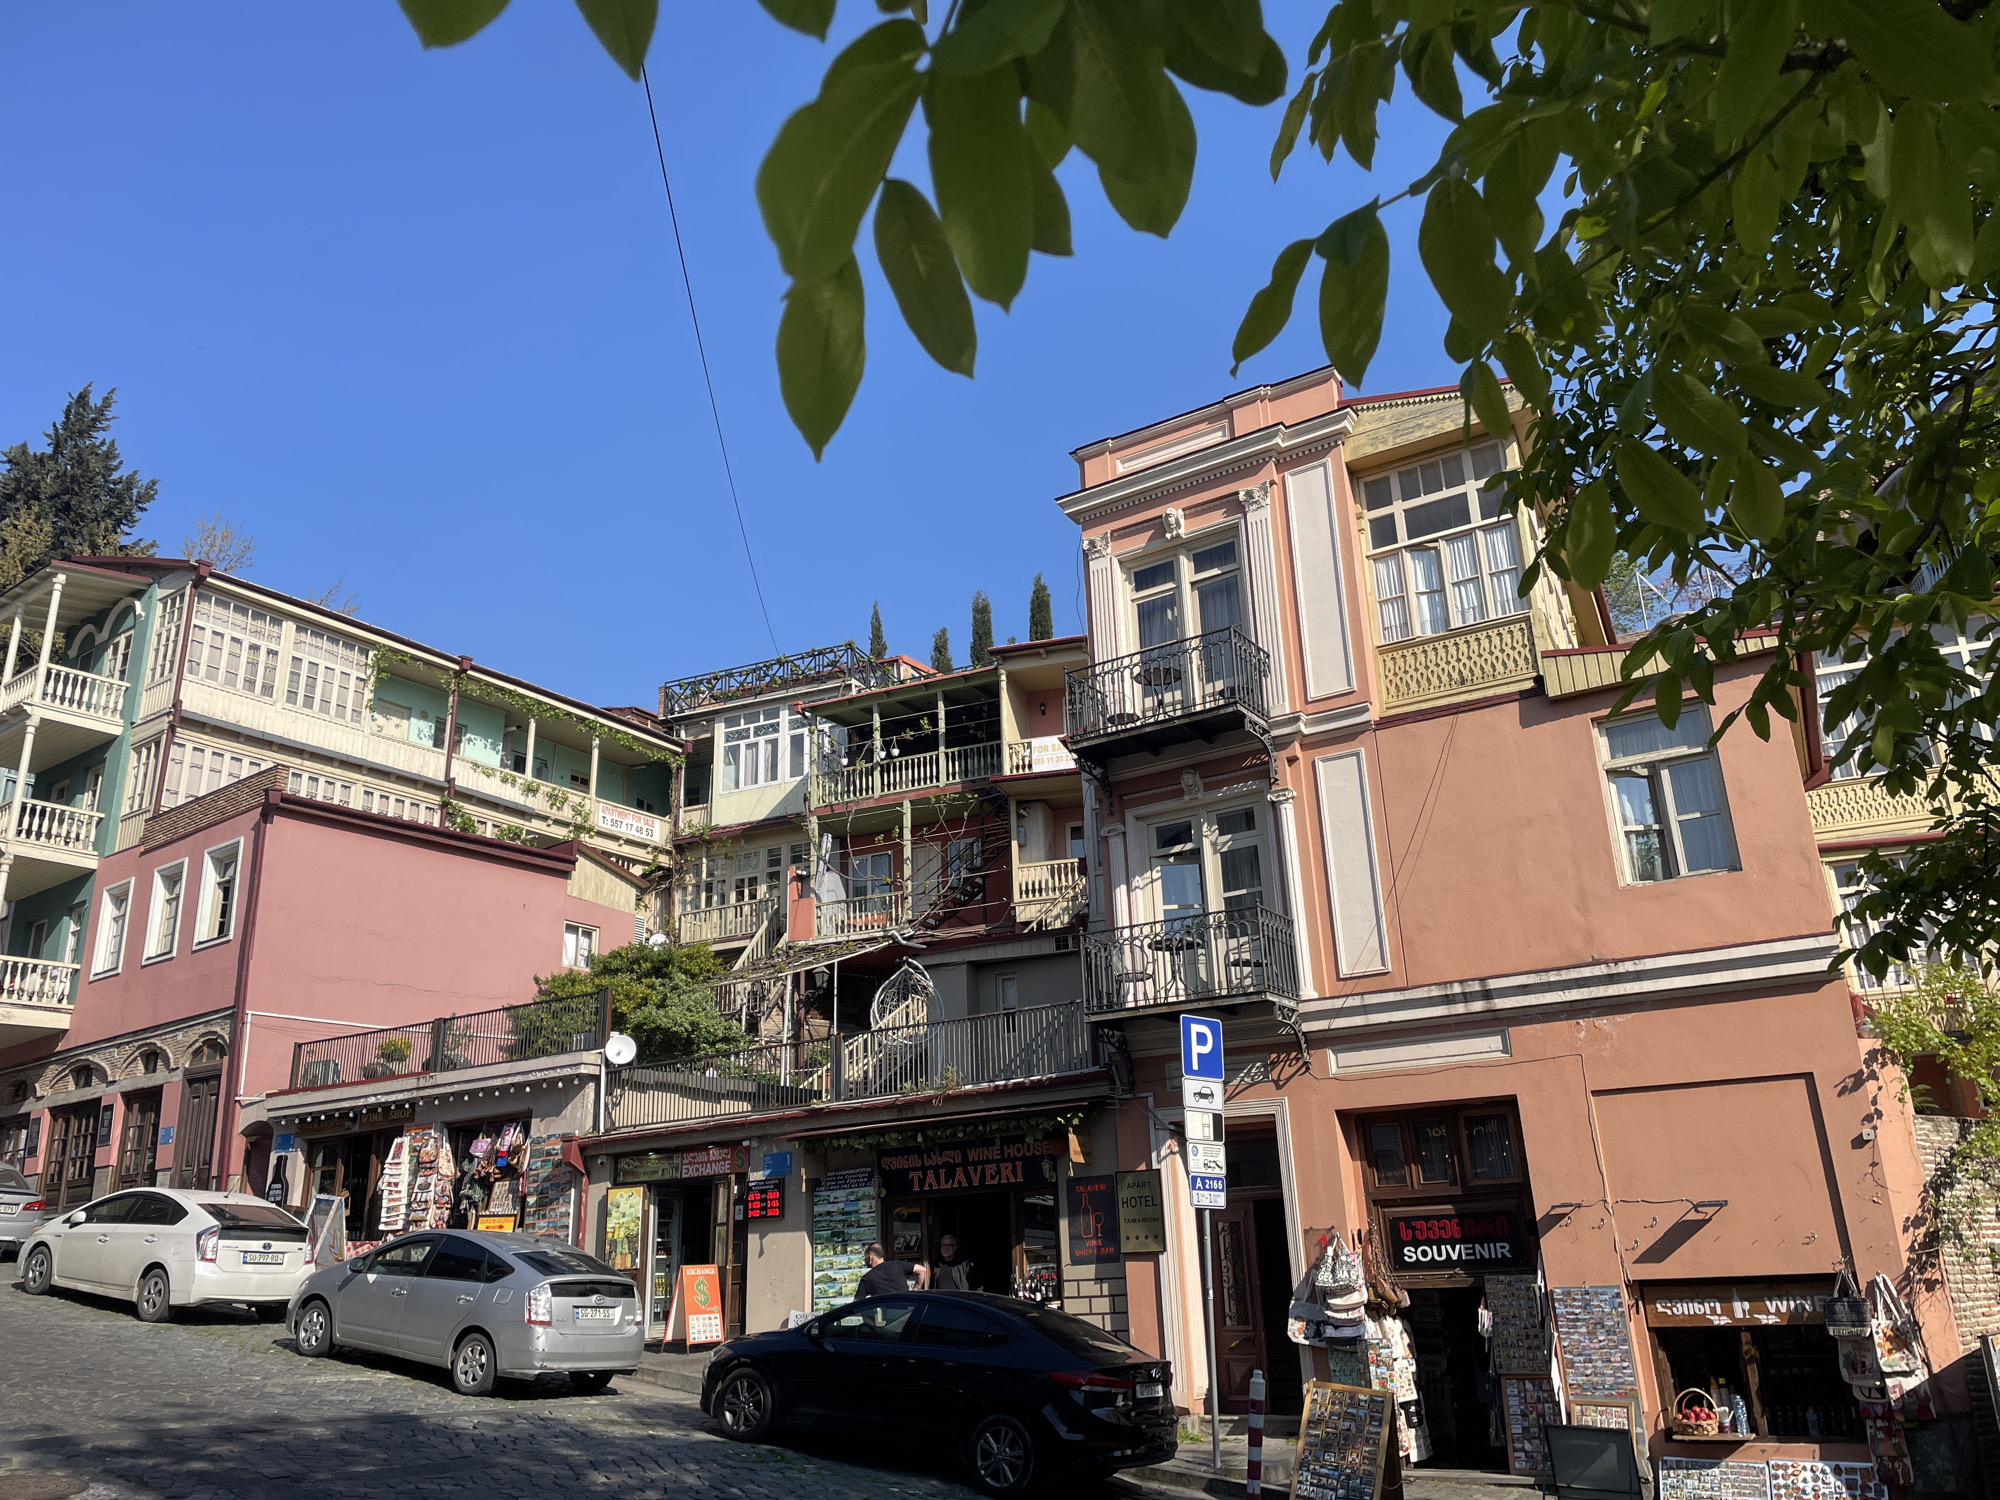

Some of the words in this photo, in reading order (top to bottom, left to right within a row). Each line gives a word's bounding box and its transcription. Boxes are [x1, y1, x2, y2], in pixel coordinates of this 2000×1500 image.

[1033, 744, 1049, 755] FOR
[1051, 742, 1067, 752] SA
[1034, 758, 1045, 766] 555
[601, 806, 630, 820] APARTMENT
[632, 813, 642, 824] FOR
[642, 816, 655, 828] SALE
[602, 816, 608, 826] T:
[610, 818, 623, 829] 557
[625, 822, 634, 832] 17
[635, 826, 644, 834] 48
[646, 828, 654, 838] 53
[1190, 1024, 1213, 1070] P
[361, 1112, 383, 1123] WINE
[388, 1108, 412, 1120] SHOP
[786, 1154, 790, 1166] 1
[881, 1156, 922, 1170] ღვინის
[924, 1150, 962, 1166] სახლი
[966, 1146, 1001, 1162] WINE
[1004, 1141, 1050, 1158] HOUSE
[682, 1160, 731, 1177] EXCHANGE
[909, 1162, 1024, 1191] TALAVERI
[1076, 1184, 1105, 1192] TALAVERI
[1127, 1181, 1151, 1189] APART
[1196, 1176, 1203, 1189] A
[1205, 1180, 1223, 1190] 2166
[1122, 1195, 1158, 1208] HOTEL
[1399, 1216, 1510, 1241] სუვენირი
[1403, 1242, 1512, 1262] SOUVENIR
[1656, 1298, 1722, 1316] ღვინო
[1764, 1295, 1827, 1314] WINE
